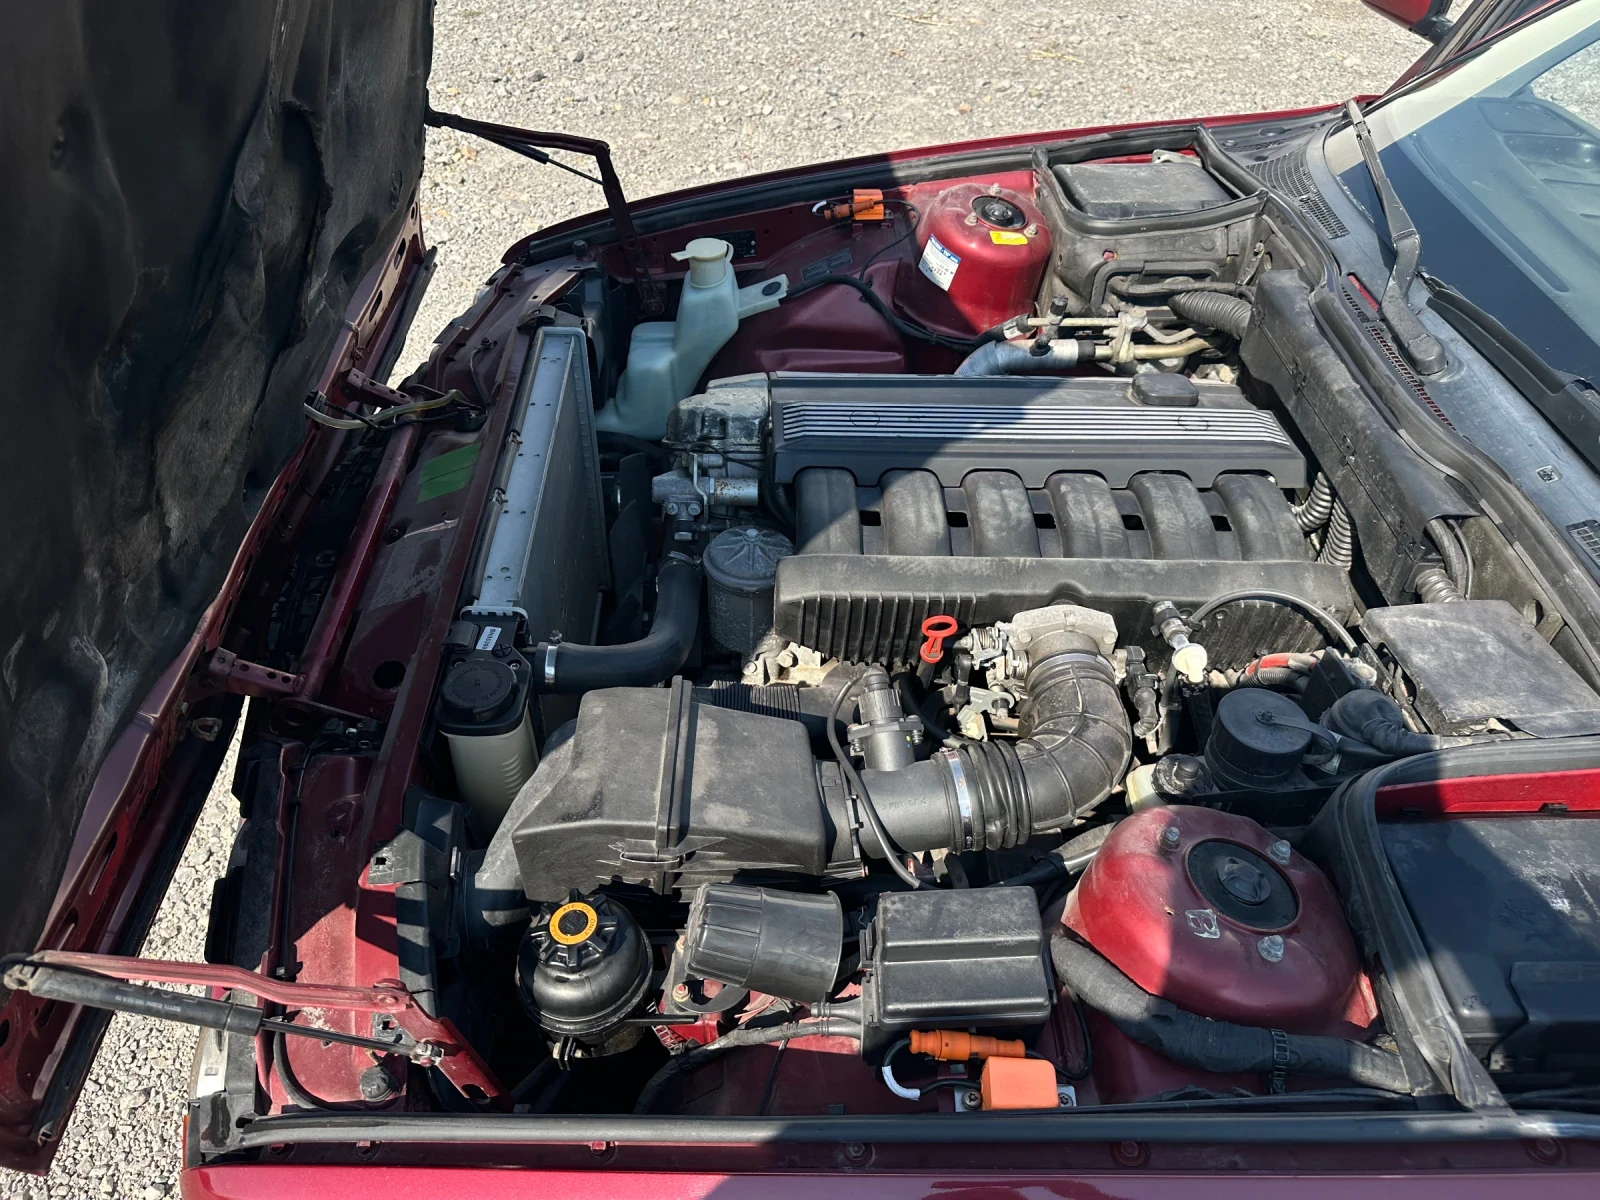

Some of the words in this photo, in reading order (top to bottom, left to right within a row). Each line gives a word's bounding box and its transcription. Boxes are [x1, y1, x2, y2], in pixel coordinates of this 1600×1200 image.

[563, 904, 575, 912] ATF
[582, 905, 591, 914] OIL
[585, 918, 596, 936] ONLY
